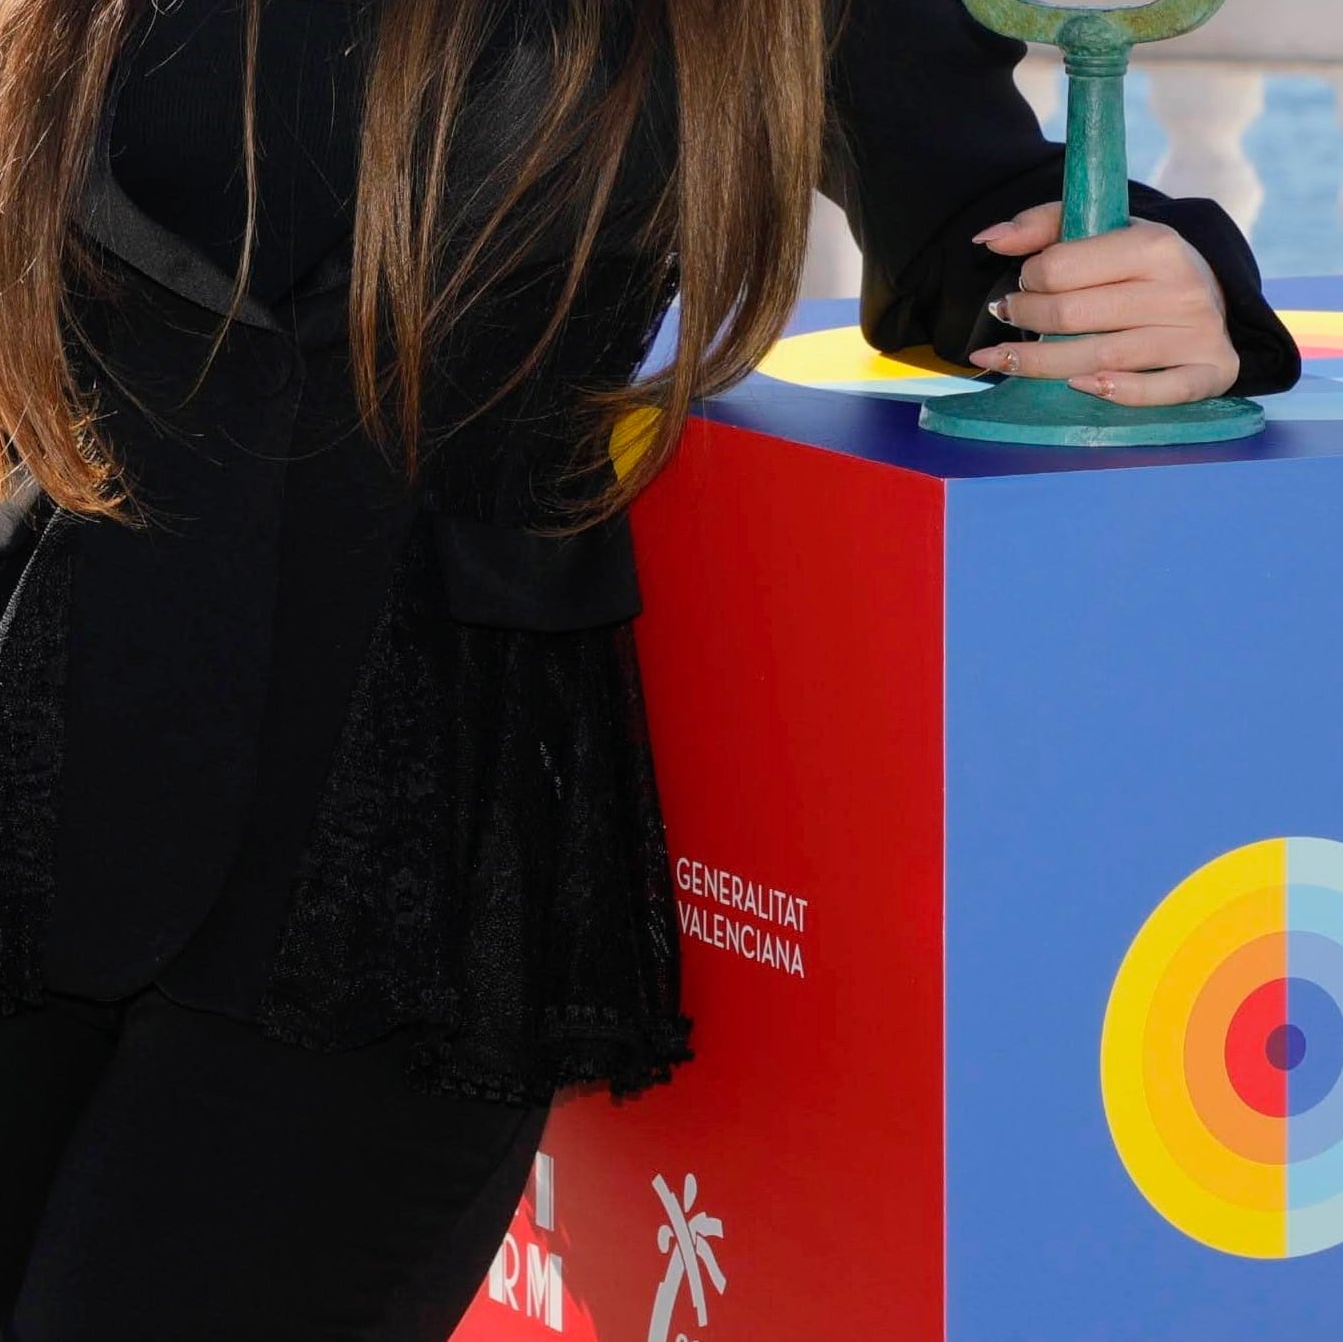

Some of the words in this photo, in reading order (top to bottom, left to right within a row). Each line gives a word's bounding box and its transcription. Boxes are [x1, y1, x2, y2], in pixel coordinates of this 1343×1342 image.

[676, 856, 808, 933] GENERALITAT
[677, 899, 805, 979] VALENCIANA
[489, 1232, 563, 1333] RM
